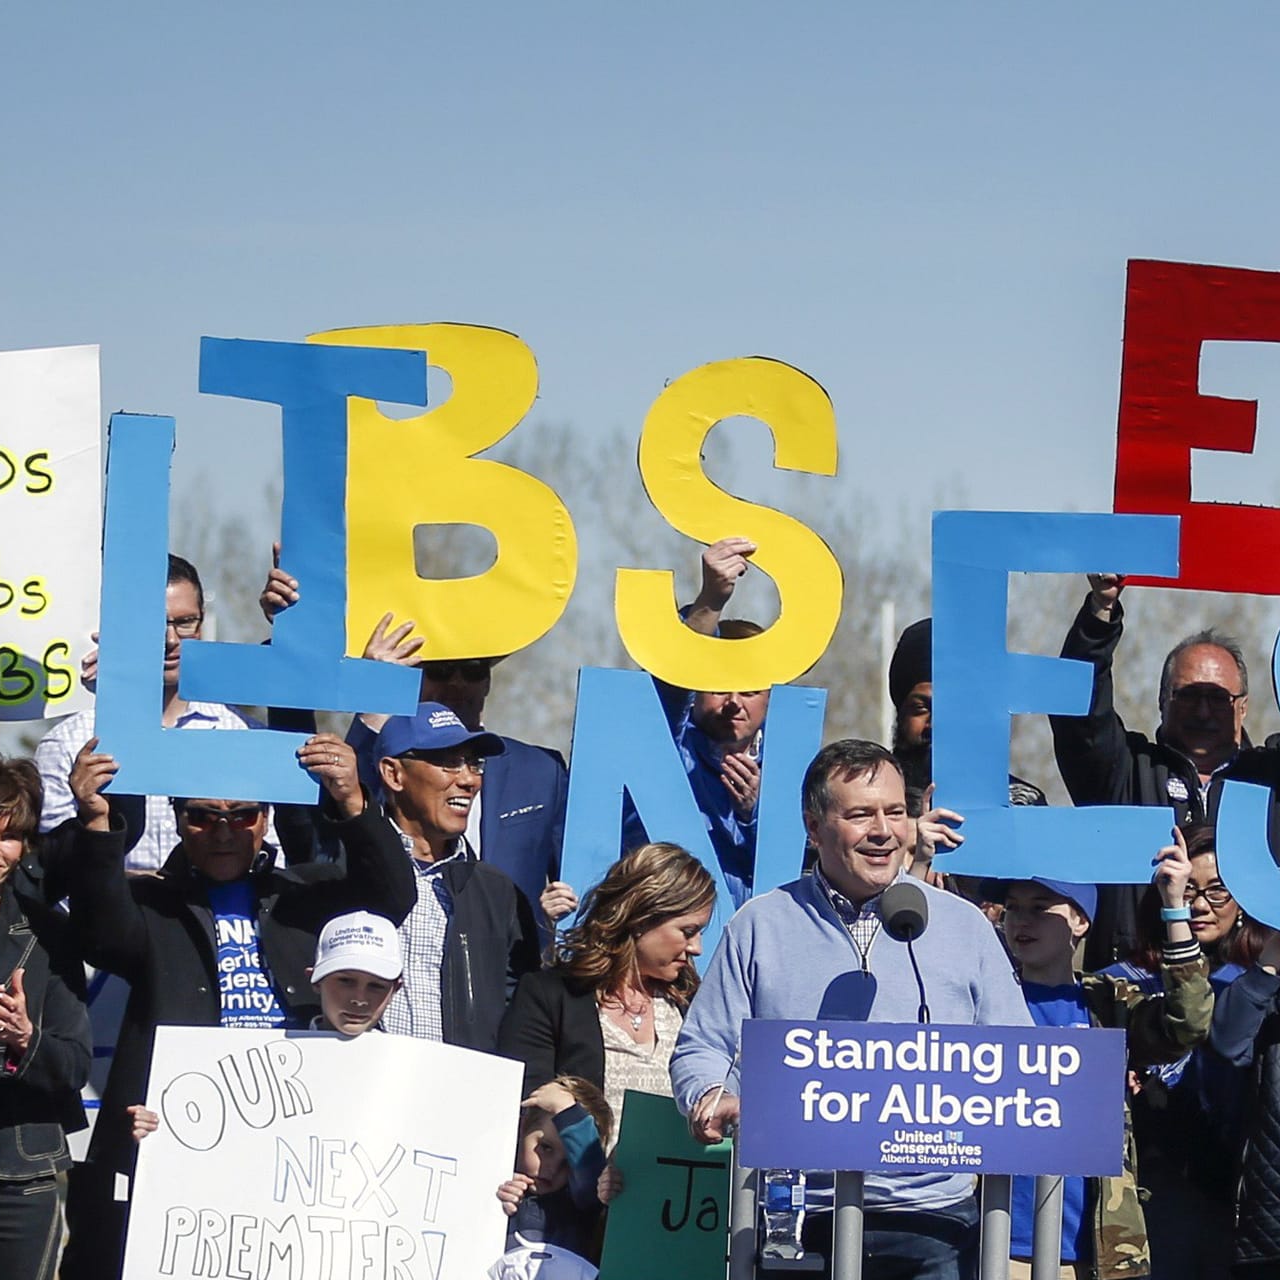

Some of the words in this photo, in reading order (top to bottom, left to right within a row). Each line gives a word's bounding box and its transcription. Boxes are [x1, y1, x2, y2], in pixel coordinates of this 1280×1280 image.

[783, 1028, 1004, 1085] Standing
[1018, 1043, 1082, 1086] up
[161, 1039, 313, 1151] OUR
[801, 1081, 870, 1122] for
[877, 1083, 1062, 1128] Alberta
[879, 1140, 982, 1156] Conservatives
[880, 1154, 915, 1164] Alberta
[917, 1154, 949, 1167] Strong
[950, 1155, 959, 1164] &
[960, 1156, 982, 1165] Free
[894, 1130, 943, 1144] United
[274, 1135, 457, 1223] NEXT
